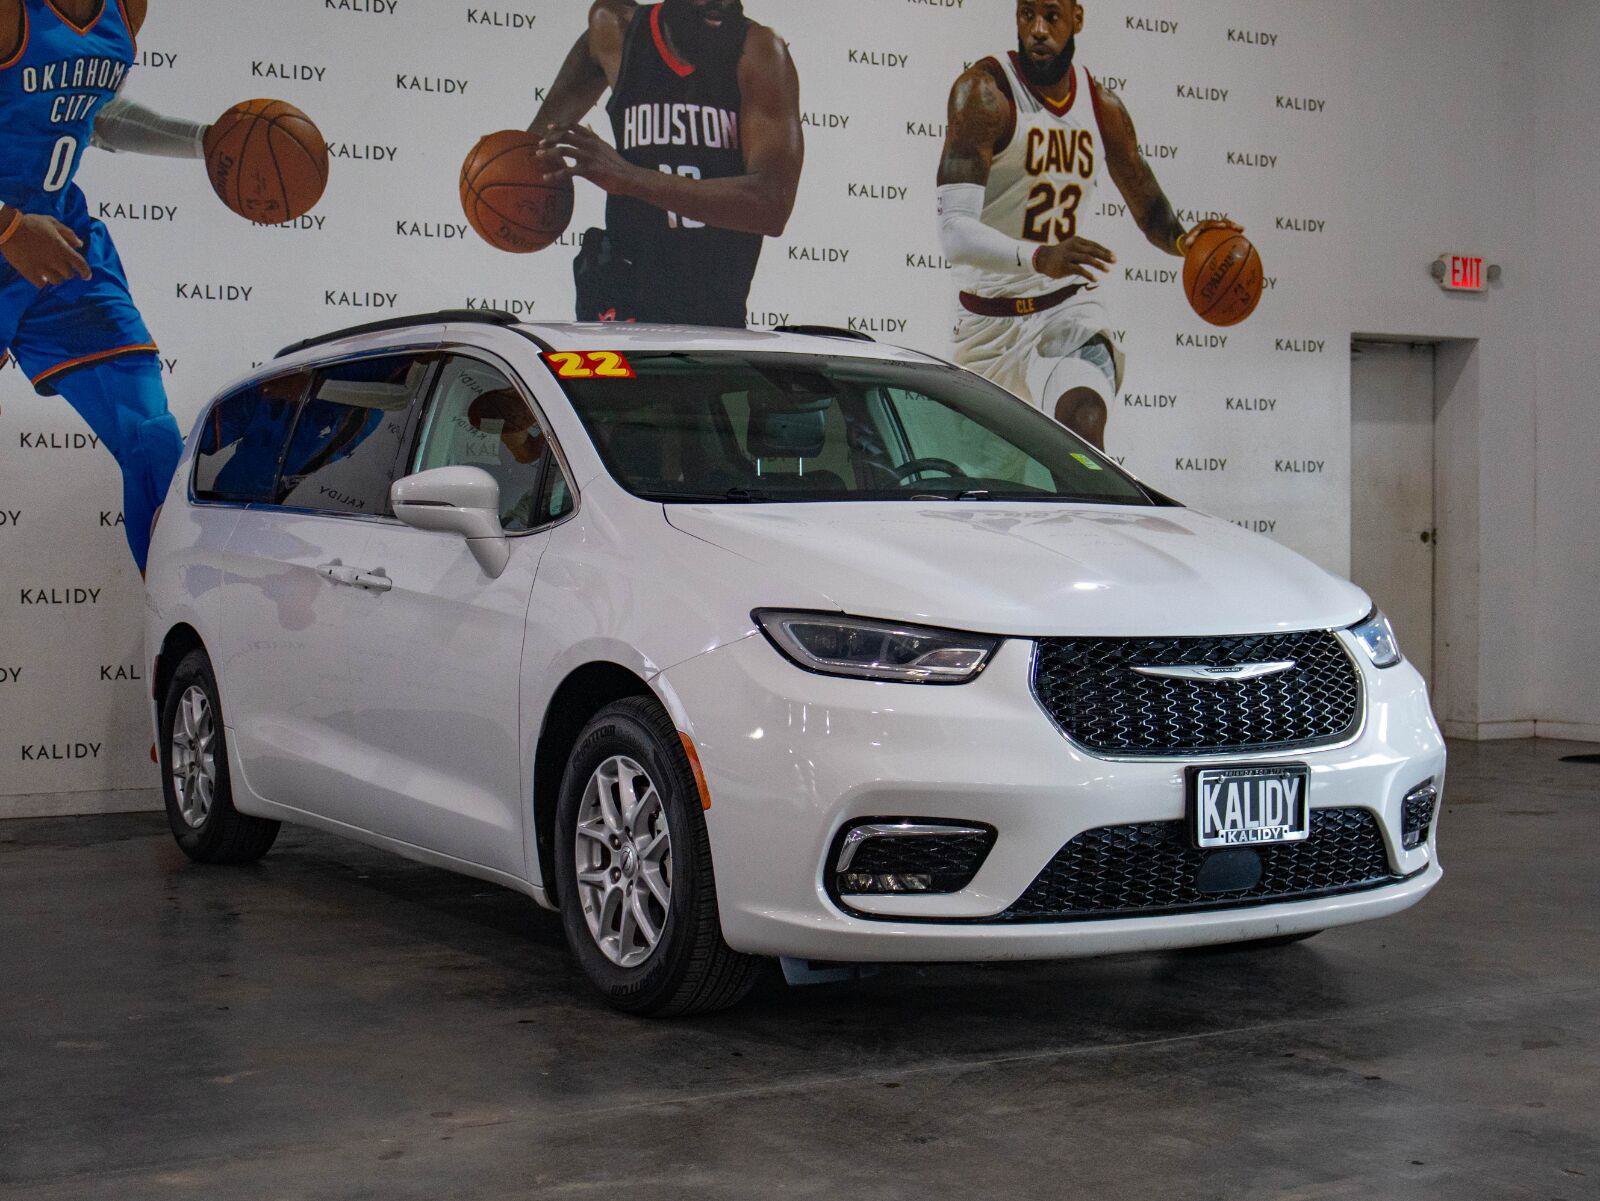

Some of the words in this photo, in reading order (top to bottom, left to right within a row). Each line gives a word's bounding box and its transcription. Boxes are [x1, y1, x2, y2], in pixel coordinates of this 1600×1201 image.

[467, 9, 536, 29] KALIDY
[1126, 16, 1178, 33] KALIDY
[1228, 29, 1277, 46] KALIDY
[849, 50, 908, 67] KALIDY
[23, 59, 125, 92] OKLAHOM
[252, 61, 327, 81] KALIDY
[397, 74, 468, 94] KALIDY
[1177, 85, 1228, 102] KALIDY
[50, 95, 97, 123] CITY
[1276, 96, 1325, 112] KALIDY
[624, 103, 738, 149] HOUSTON
[801, 112, 849, 128] ALIDY
[325, 142, 397, 161] KALIDY
[1024, 128, 1094, 179] CAVS
[1137, 144, 1178, 158] ALIDY
[43, 136, 77, 192] 0
[1227, 152, 1277, 168] KALIDY
[848, 183, 907, 200] KALIDY
[98, 202, 177, 221] KALIDY
[1022, 182, 1082, 243] 23
[397, 220, 468, 239] KALIDY
[1276, 217, 1325, 233] KALIDY
[789, 246, 849, 262] KALIDY
[1125, 267, 1177, 283] KALIDY
[1451, 256, 1482, 288] EXIT
[177, 283, 252, 301] KALIDY
[325, 290, 397, 307] KALIDY
[1016, 300, 1035, 314] CLE
[848, 317, 906, 334] KALIDY
[1176, 333, 1227, 348] KALIDY
[1276, 339, 1325, 353] KALIDY
[548, 352, 630, 377] 22
[1125, 394, 1177, 408] KALIDY
[1226, 398, 1276, 411] KALIDY
[21, 433, 99, 449] KALIDY
[1176, 458, 1227, 472] KALIDY
[1275, 460, 1324, 473] KALIDY
[21, 589, 101, 604] KALIDY
[101, 665, 140, 680] KAL
[22, 743, 101, 760] KALIDY
[1204, 778, 1299, 833] KALIDY
[1227, 828, 1280, 843] KALIDY
